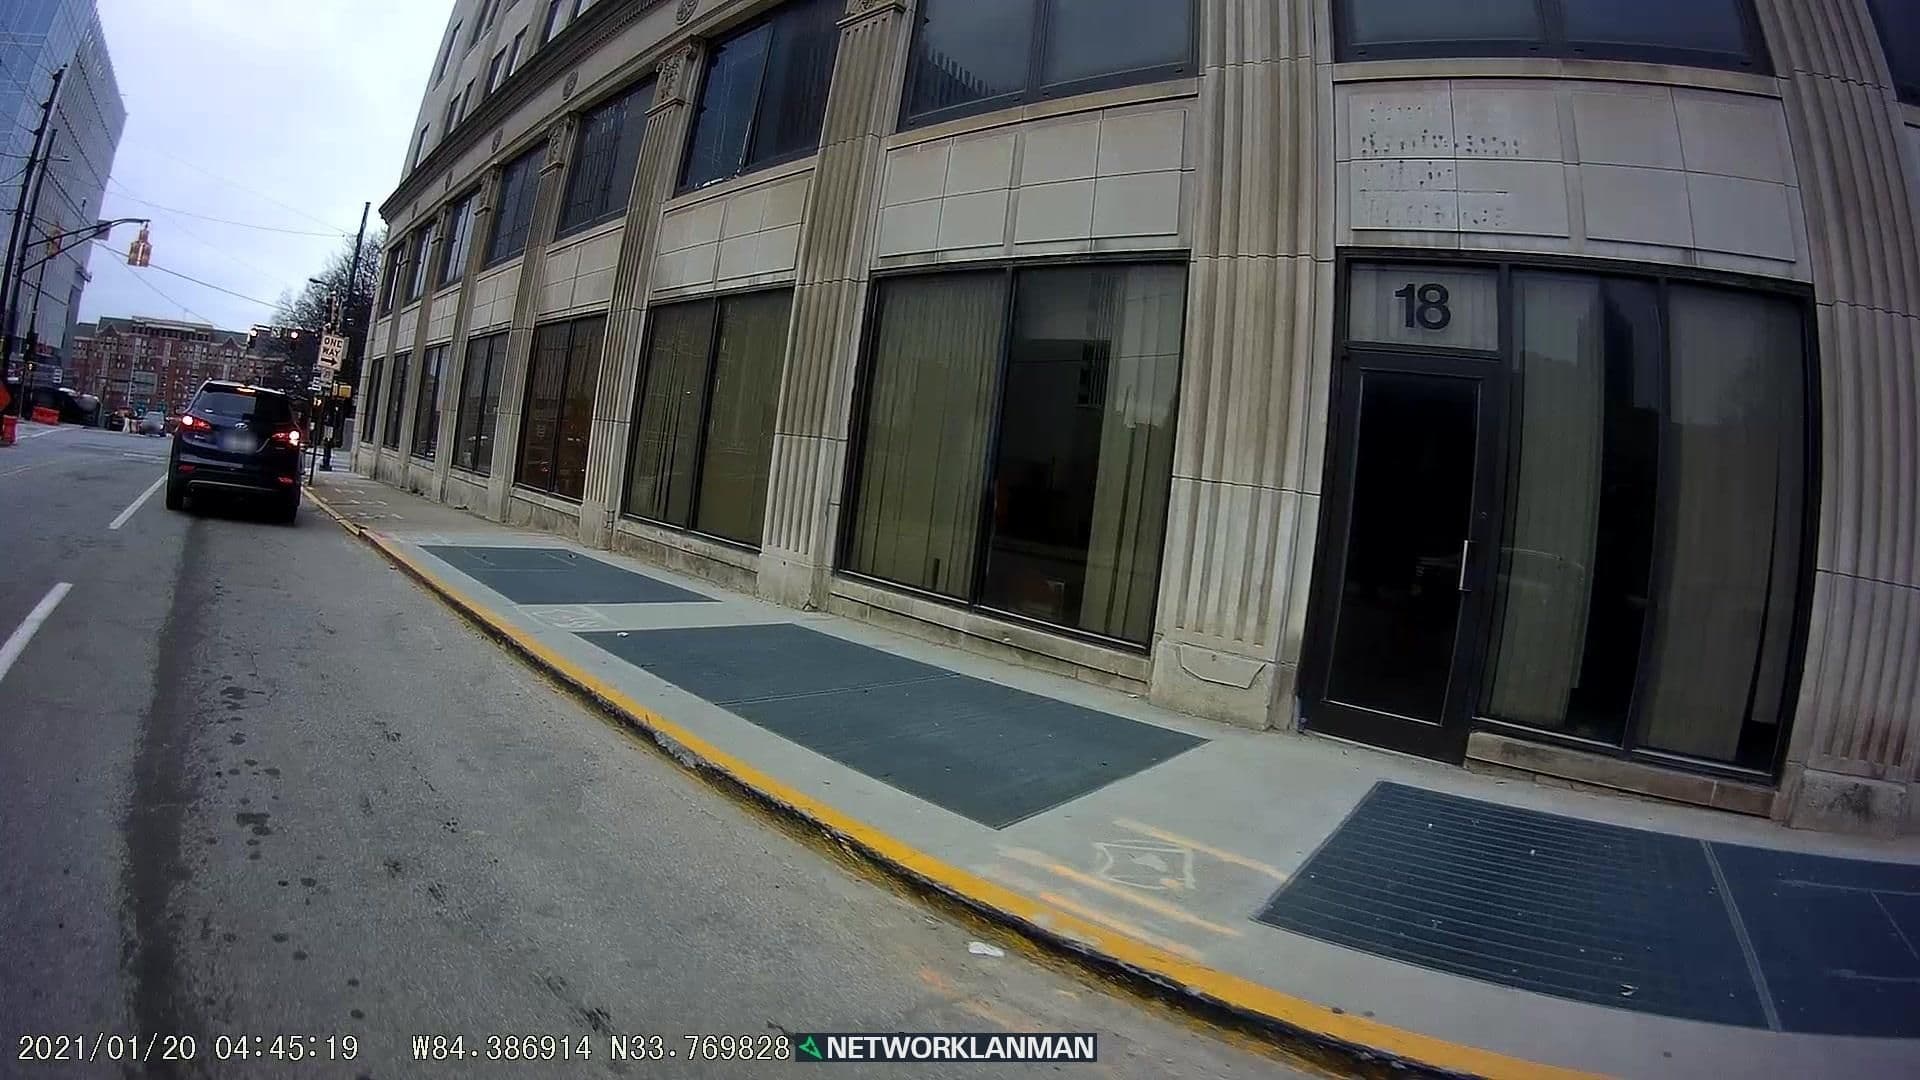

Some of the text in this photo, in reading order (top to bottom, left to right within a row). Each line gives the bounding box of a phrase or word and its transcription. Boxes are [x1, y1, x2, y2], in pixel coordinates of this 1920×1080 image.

[1395, 283, 1451, 330] 18
[324, 337, 343, 348] ONE
[322, 346, 340, 357] WAY
